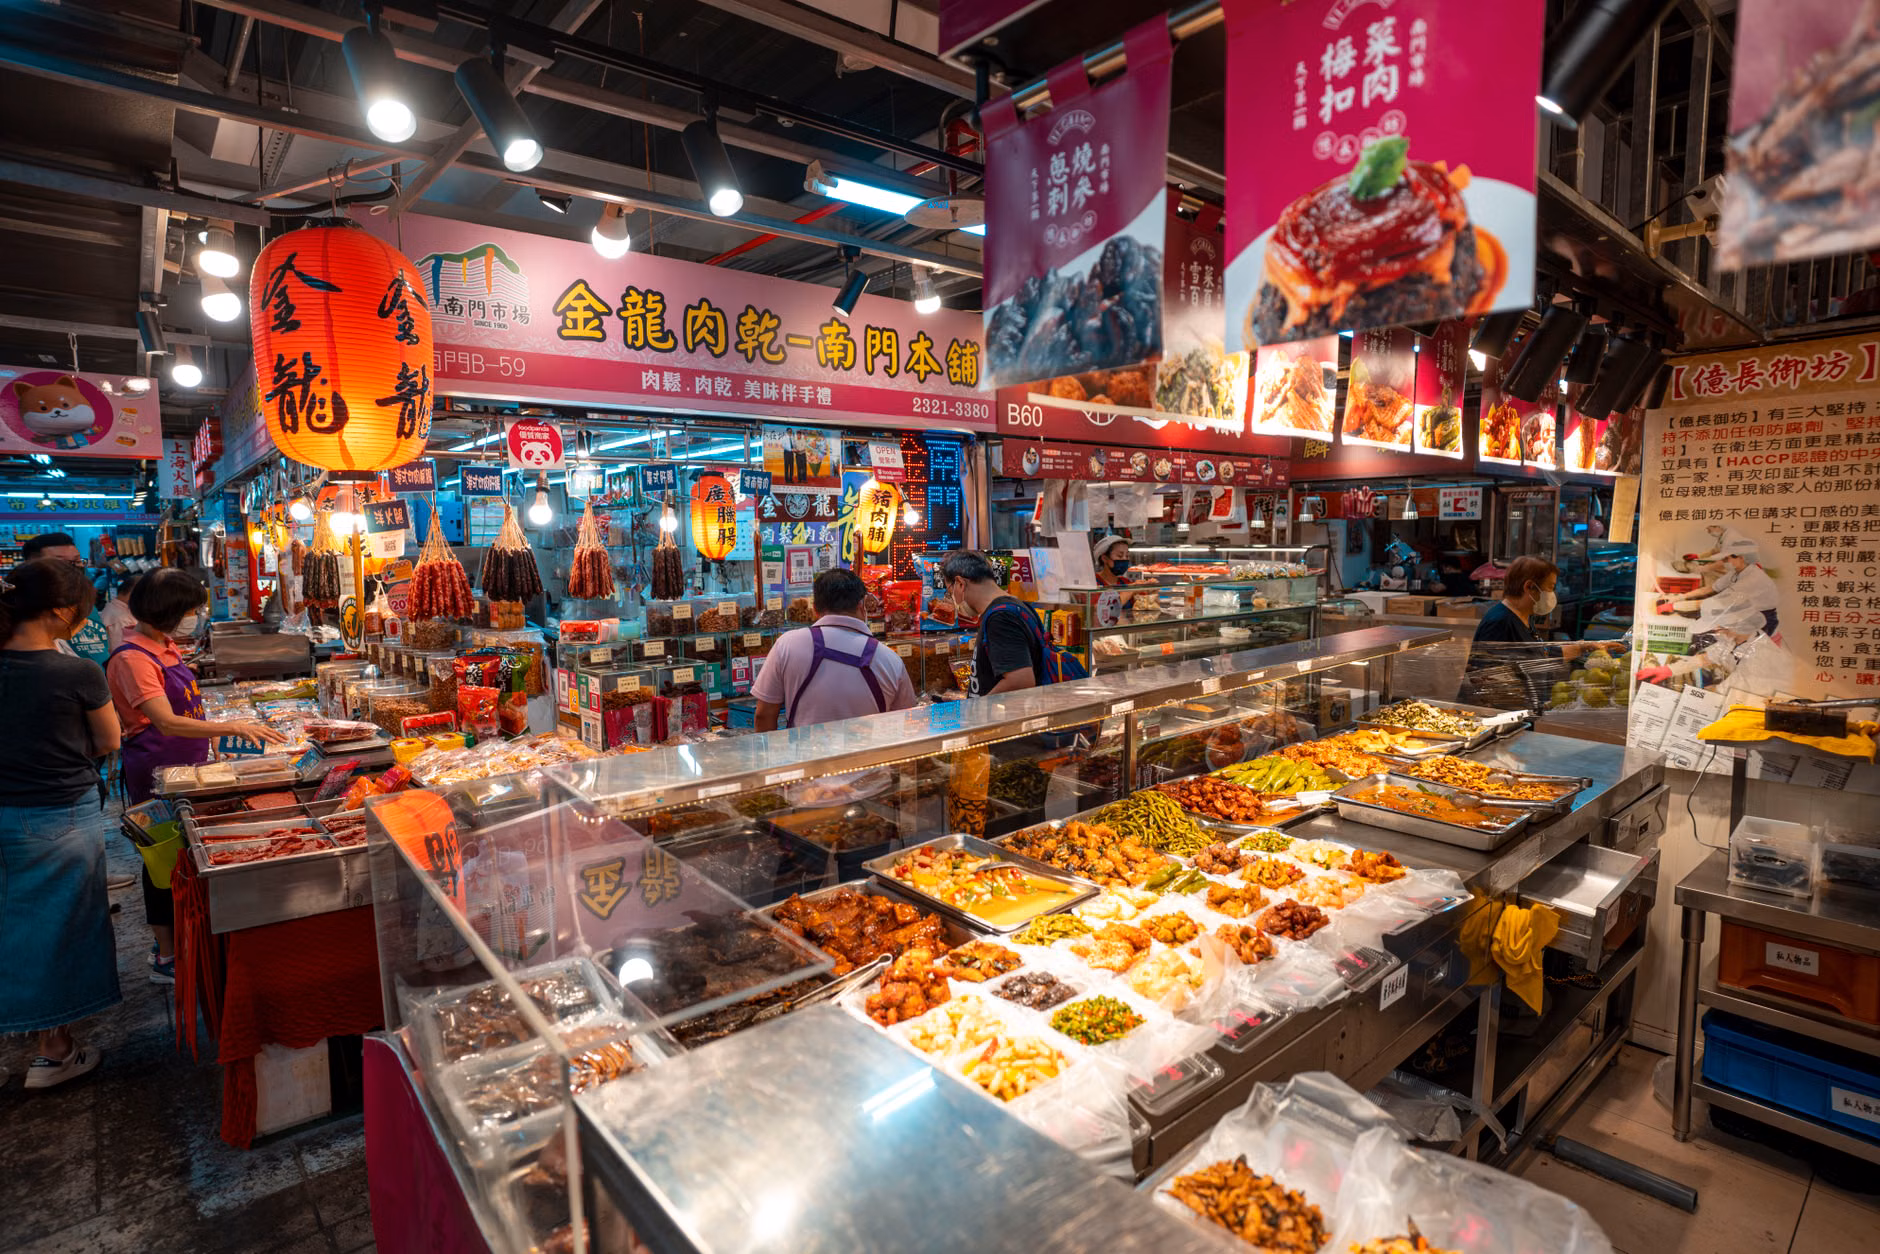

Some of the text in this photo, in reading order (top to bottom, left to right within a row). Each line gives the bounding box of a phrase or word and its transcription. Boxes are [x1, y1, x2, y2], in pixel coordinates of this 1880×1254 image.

[443, 295, 531, 325] 南門市場
[474, 320, 493, 328] SINCE
[261, 252, 350, 435] 金龍
[376, 268, 433, 441] 金龍
[1671, 343, 1878, 401] 【億長御坊】
[913, 396, 989, 420] 2321-3380
[1007, 403, 1043, 428] B60
[518, 424, 550, 432] foodpanda
[876, 446, 897, 455] OPEN
[171, 441, 191, 497] 上海火腿
[758, 493, 783, 518] 金
[1796, 550, 1880, 564] 食材則嚴
[391, 600, 406, 610] 20
[1689, 689, 1705, 699] SGS
[1776, 951, 1811, 967] 私人物品
